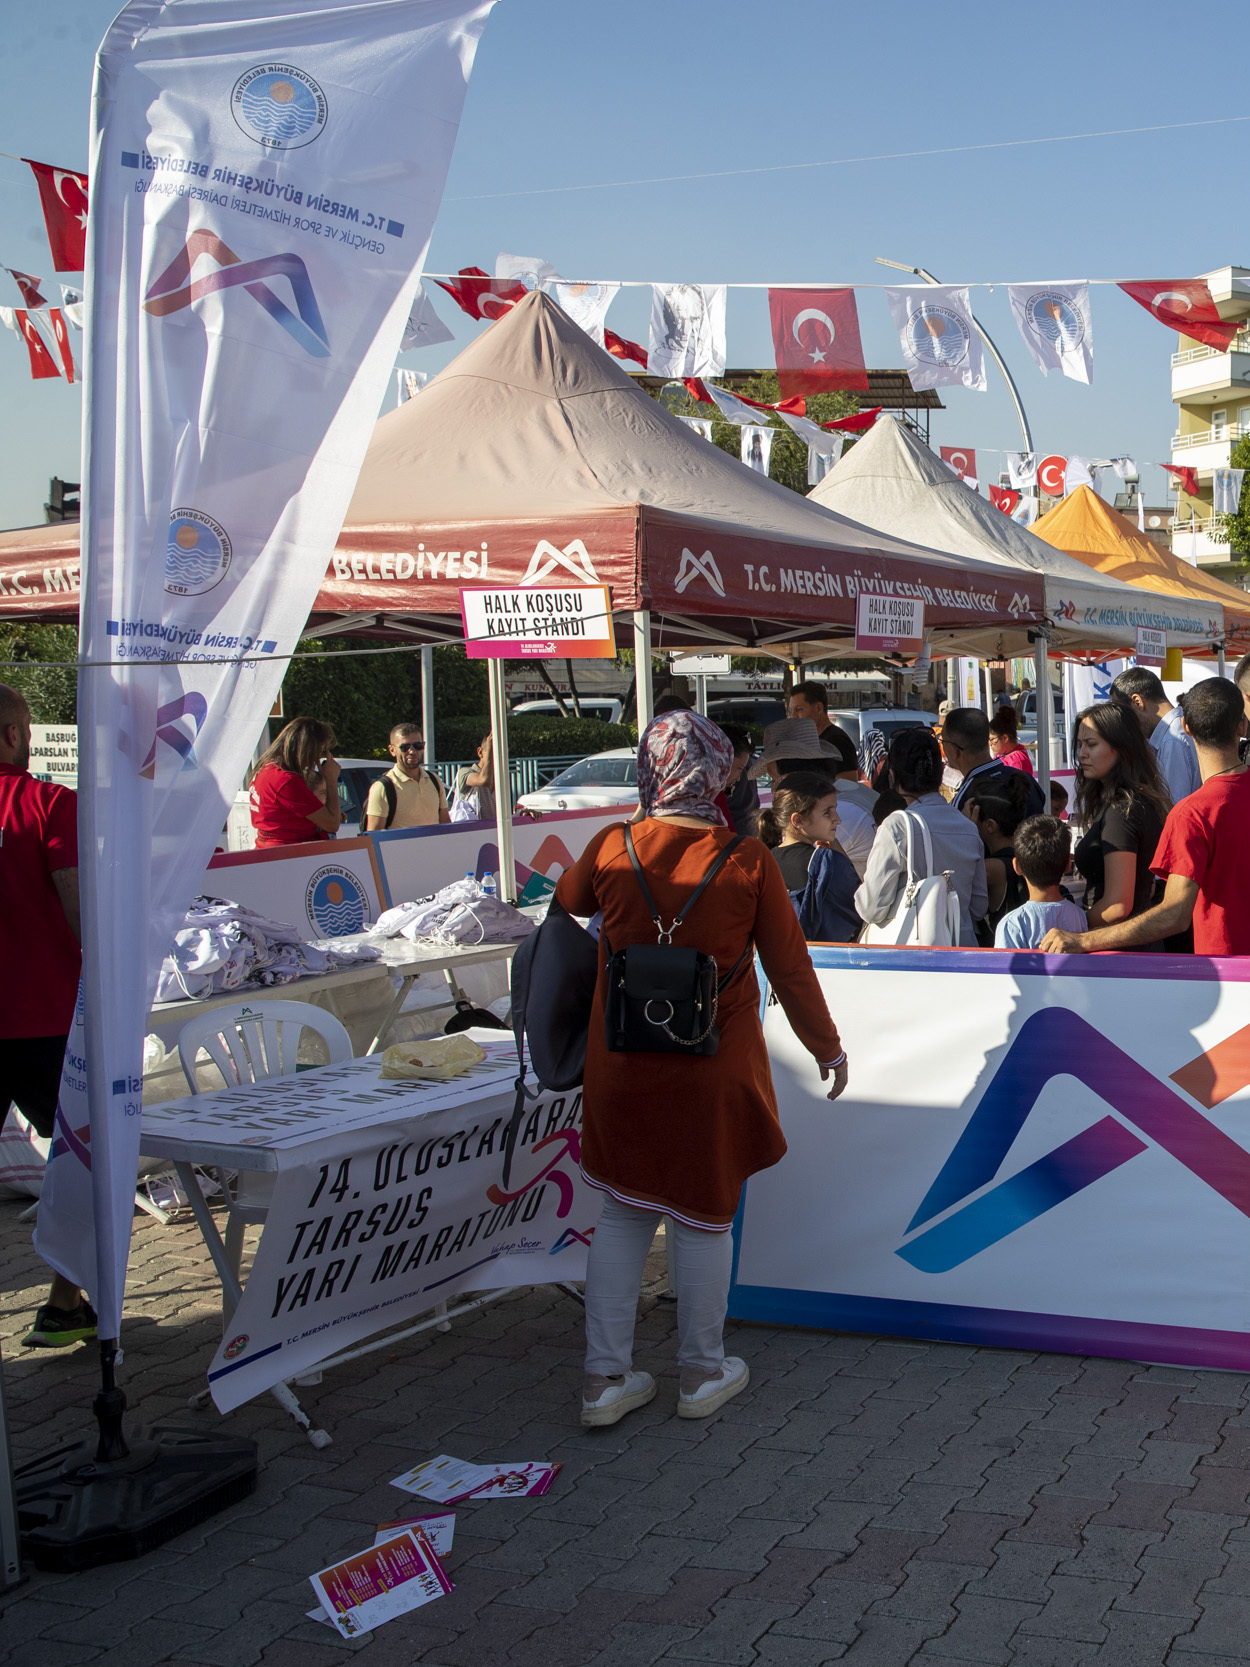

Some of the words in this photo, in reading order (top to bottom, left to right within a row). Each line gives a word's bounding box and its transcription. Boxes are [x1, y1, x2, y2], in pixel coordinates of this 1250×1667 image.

[331, 541, 489, 581] BELEDİYESİ
[483, 594, 521, 614] HALK
[525, 592, 584, 617] KOŞUSU
[743, 563, 777, 593] T.C.
[779, 564, 845, 599] MERSİN
[934, 585, 1000, 614] BELEDİYESİ
[868, 598, 887, 616] HALK
[889, 600, 915, 620] KOŞUSU
[1097, 605, 1128, 627] MERSİN
[486, 617, 527, 637] KAYIT
[532, 616, 586, 637] STANDI
[868, 617, 889, 634] KAYIT
[890, 618, 914, 636] STANDI
[30, 747, 69, 758] LPARSLAN
[45, 731, 77, 745] BAŞBUĞ
[310, 867, 344, 889] BÜYÜKŞEHİR
[344, 871, 369, 911] BELEDİYESİ
[180, 1088, 350, 1126] TARSUS
[230, 1105, 348, 1131] YARI
[307, 1157, 362, 1209] 14.
[286, 1186, 434, 1265] TARSUS
[270, 1254, 363, 1319] YARI
[369, 1184, 548, 1286] MARATONU
[286, 1334, 300, 1346] T.C.
[301, 1321, 331, 1341] MERSİN
[331, 1302, 381, 1326] BÜYÜKŞEHİR
[381, 1288, 420, 1312] BELEDİYESİ
